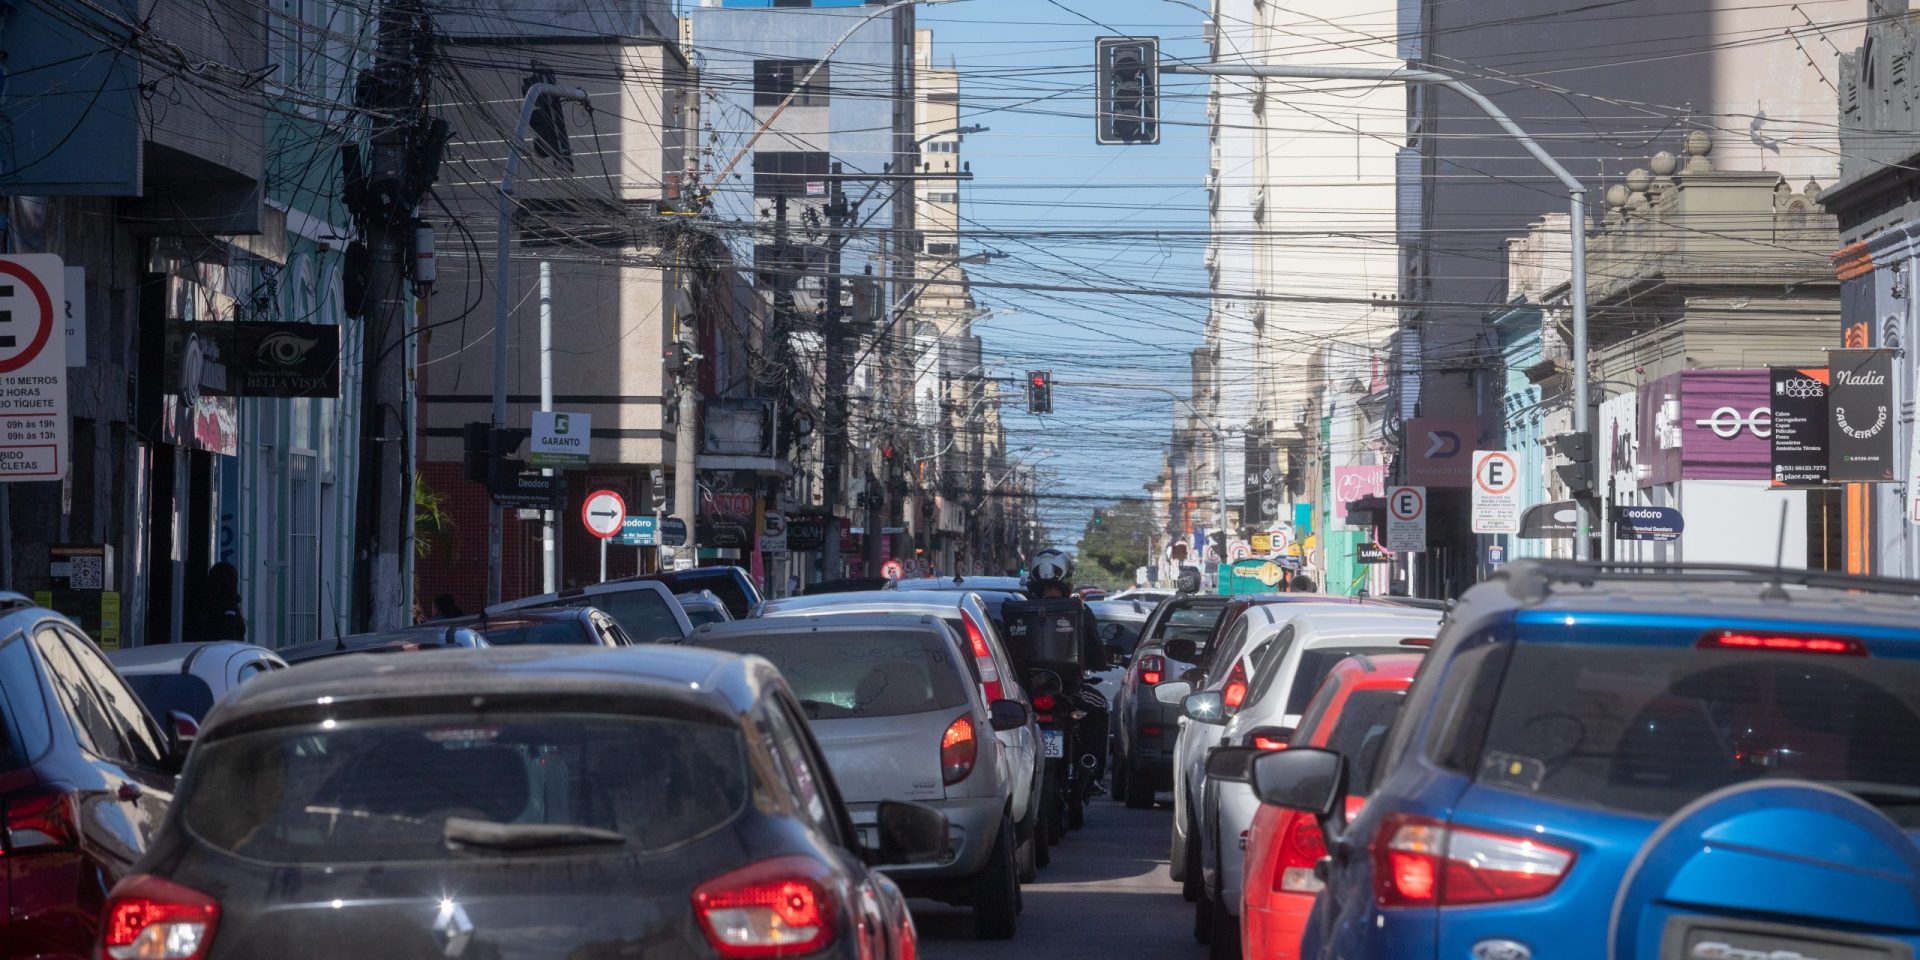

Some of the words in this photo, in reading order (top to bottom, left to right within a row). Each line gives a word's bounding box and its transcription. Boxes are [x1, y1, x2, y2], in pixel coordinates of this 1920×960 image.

[6, 377, 15, 385] 10
[18, 376, 58, 385] METROS
[291, 377, 328, 388] VISTA
[1786, 376, 1822, 389] place
[1836, 370, 1885, 386] Nadia
[6, 388, 41, 397] HORAS
[1787, 388, 1824, 399] capas
[7, 420, 23, 429] 09h
[39, 420, 55, 428] 19h
[1836, 405, 1887, 439] CABELEIREIROS
[7, 432, 24, 440] 09h
[26, 432, 37, 440] às
[39, 431, 56, 440] 13h
[541, 436, 581, 447] GARANTO
[0, 461, 38, 470] CLETAS
[1489, 461, 1504, 486] E
[518, 478, 550, 489] Deodoro
[704, 493, 753, 516] TATTOO
[1400, 495, 1413, 514] E
[1622, 508, 1663, 519] Deodoro
[1361, 550, 1383, 558] LUNA
